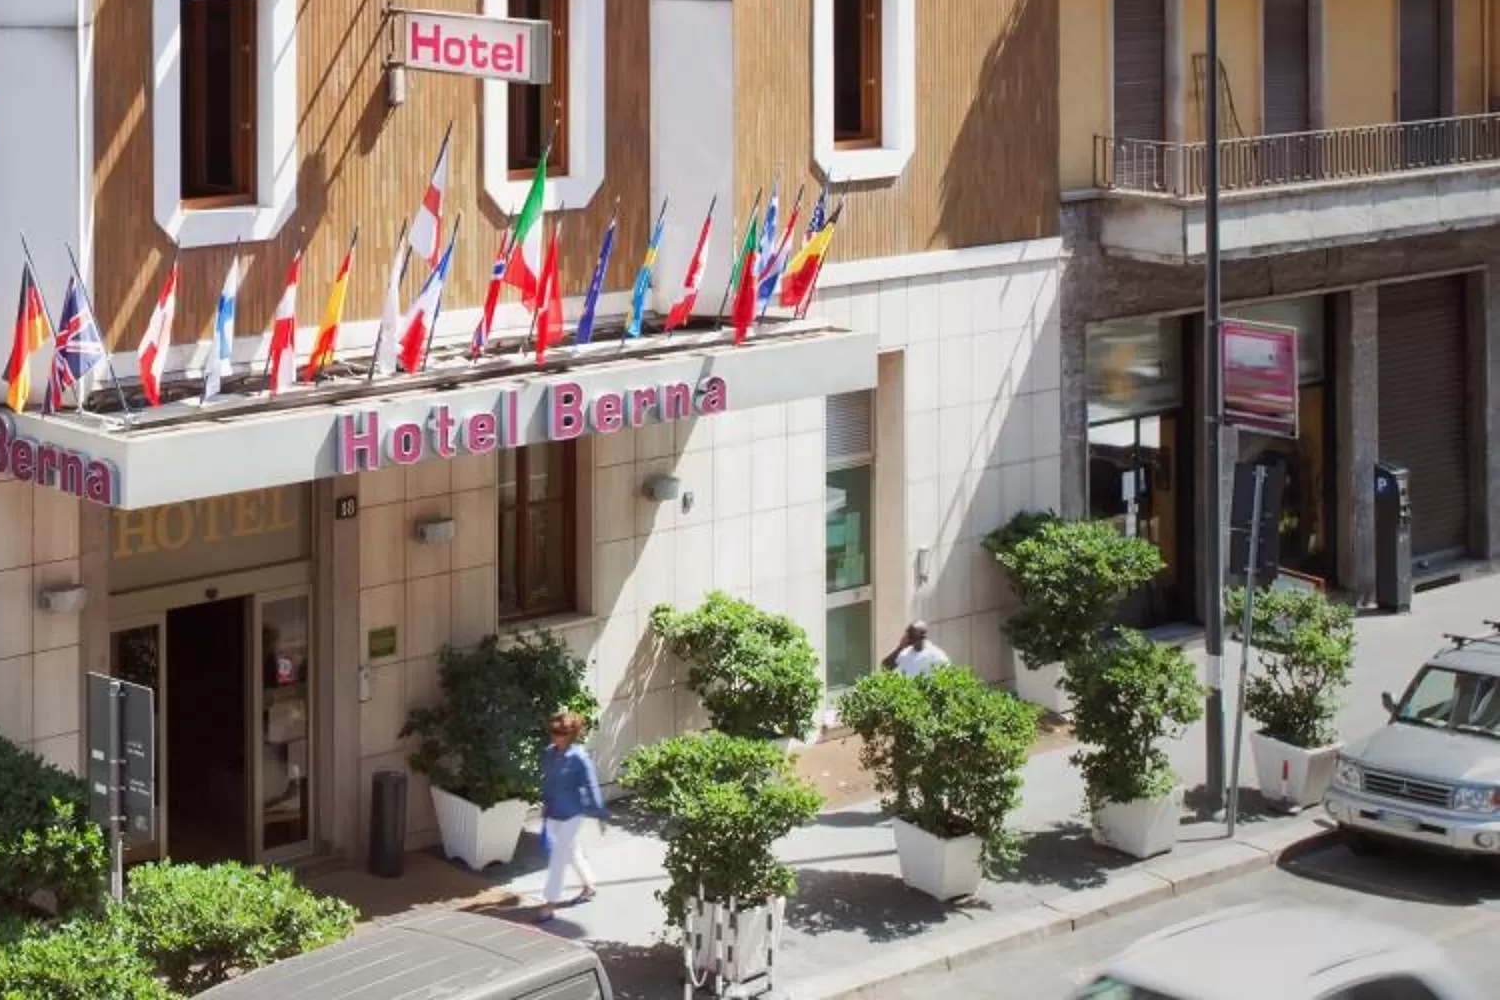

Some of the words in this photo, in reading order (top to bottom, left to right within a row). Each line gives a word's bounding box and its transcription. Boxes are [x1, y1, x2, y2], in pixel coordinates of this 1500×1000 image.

[411, 21, 524, 73] Hotel
[342, 389, 518, 474] Hotel
[552, 375, 728, 440] Berna
[113, 487, 297, 560] HOTEL
